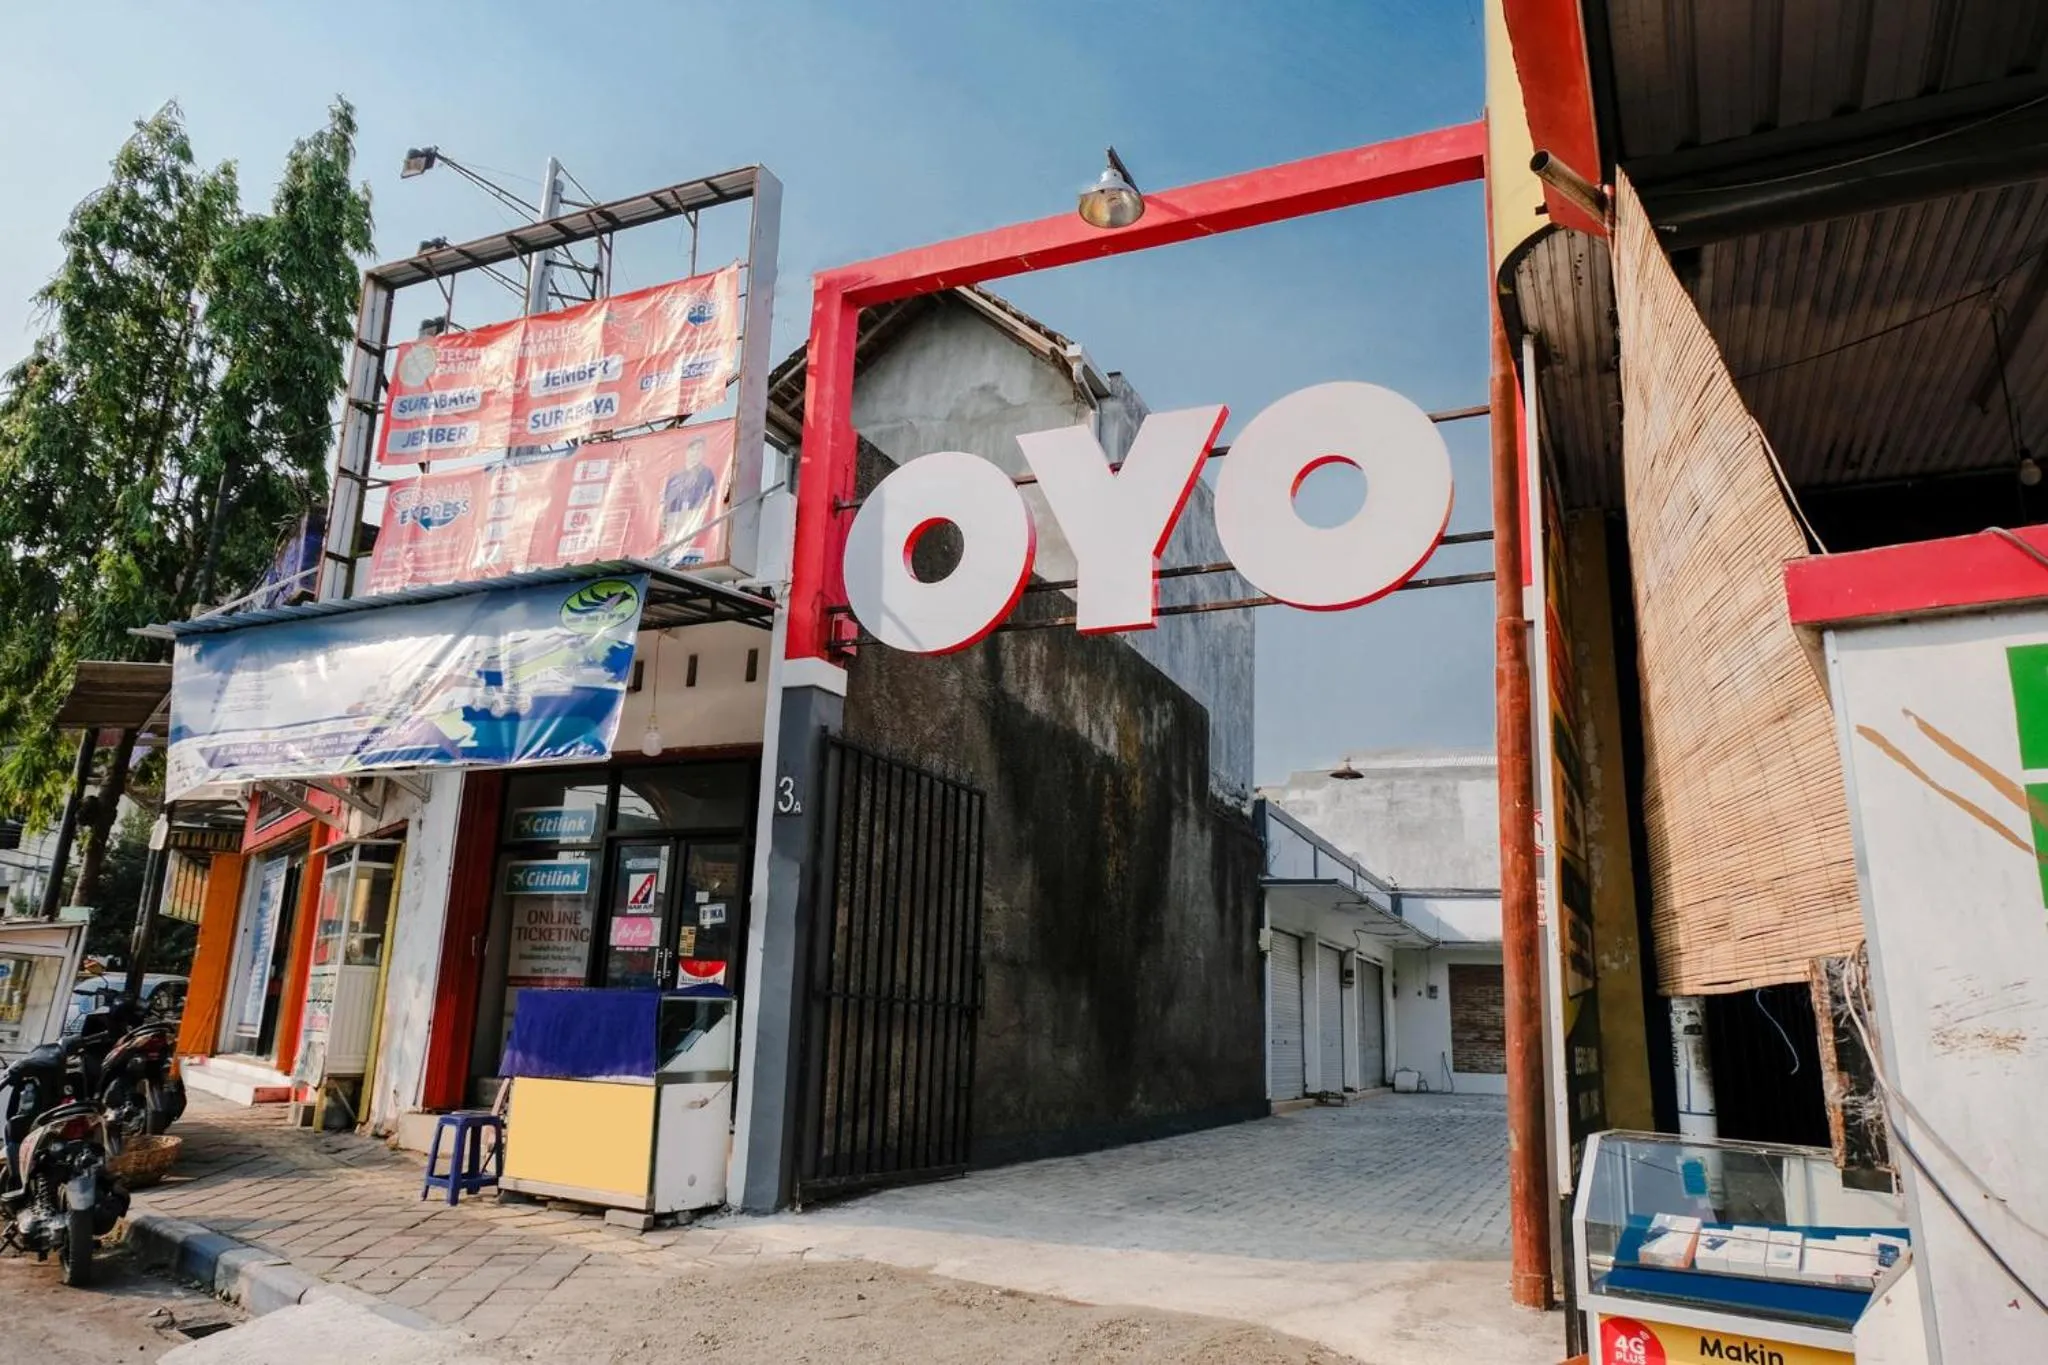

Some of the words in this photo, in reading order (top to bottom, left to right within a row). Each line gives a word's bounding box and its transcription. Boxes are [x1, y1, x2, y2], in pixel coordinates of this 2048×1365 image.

[542, 359, 609, 389] JEMBER
[398, 387, 478, 414] SURABAYA
[531, 398, 615, 429] SURABAYA
[402, 425, 469, 448] JEMBER
[399, 499, 470, 525] EXPRESS
[842, 380, 1454, 657] OYO
[532, 815, 587, 833] Citilink
[526, 867, 582, 887] Citilink
[527, 909, 582, 926] ONLINE
[514, 926, 591, 943] TICKETING
[1614, 1334, 1646, 1355] 4G
[1700, 1336, 1784, 1365] Makin
[1615, 1351, 1647, 1365] PLUS
